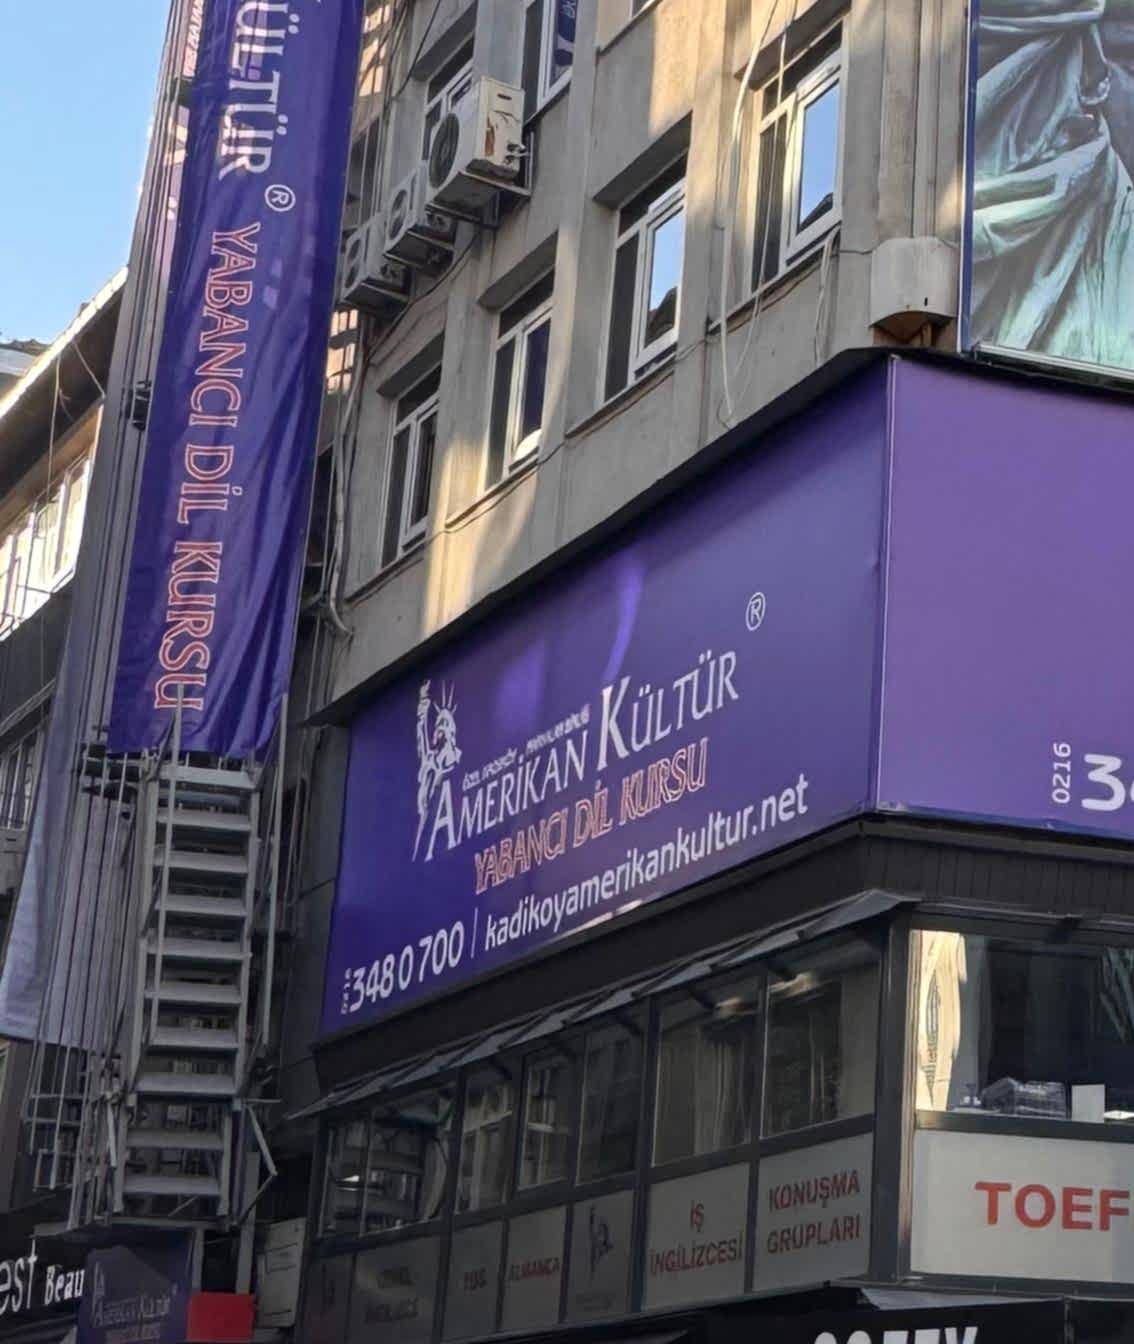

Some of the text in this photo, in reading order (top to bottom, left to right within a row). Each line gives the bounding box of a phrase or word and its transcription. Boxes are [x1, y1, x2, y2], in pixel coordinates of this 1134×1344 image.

[154, 222, 262, 712] YABANCI DİL KURSU
[426, 730, 590, 862] AMERİKAN
[596, 649, 740, 772] KÜLTÜR
[473, 737, 709, 896] YABANCI DİL KURSU
[1052, 742, 1072, 805] 0216
[484, 773, 809, 951] kadikoyamerikankultur.net
[350, 953, 396, 1013] 348
[419, 920, 465, 983] 700
[767, 1213, 860, 1254] GRUPLARI
